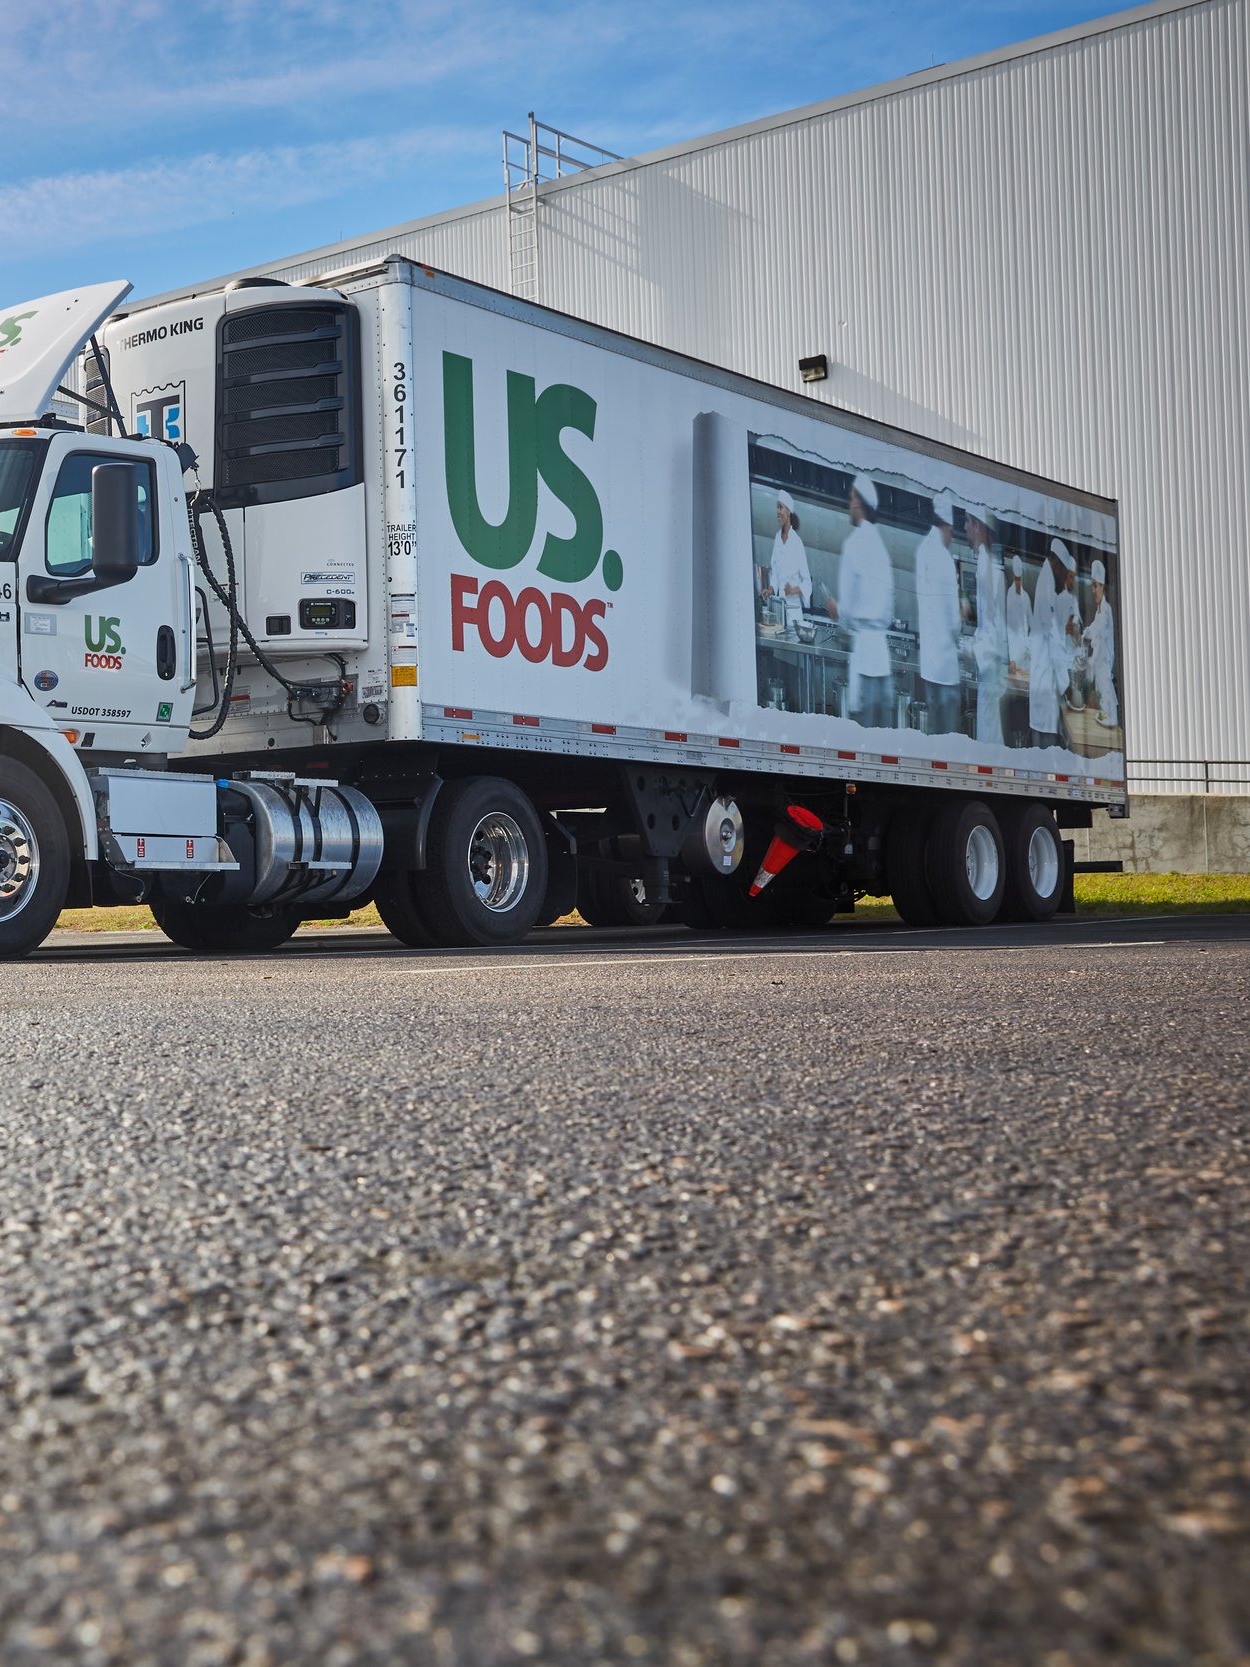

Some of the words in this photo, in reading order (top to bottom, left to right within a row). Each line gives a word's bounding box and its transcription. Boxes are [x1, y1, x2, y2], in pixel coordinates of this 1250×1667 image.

[170, 317, 204, 337] KING
[393, 362, 407, 489] 361171
[386, 524, 417, 533] TRAILER
[388, 533, 416, 541] HEIGHT
[451, 573, 609, 672] FOODS
[85, 653, 123, 670] FOODS
[71, 706, 100, 716] USDOT
[101, 708, 131, 718] 358597
